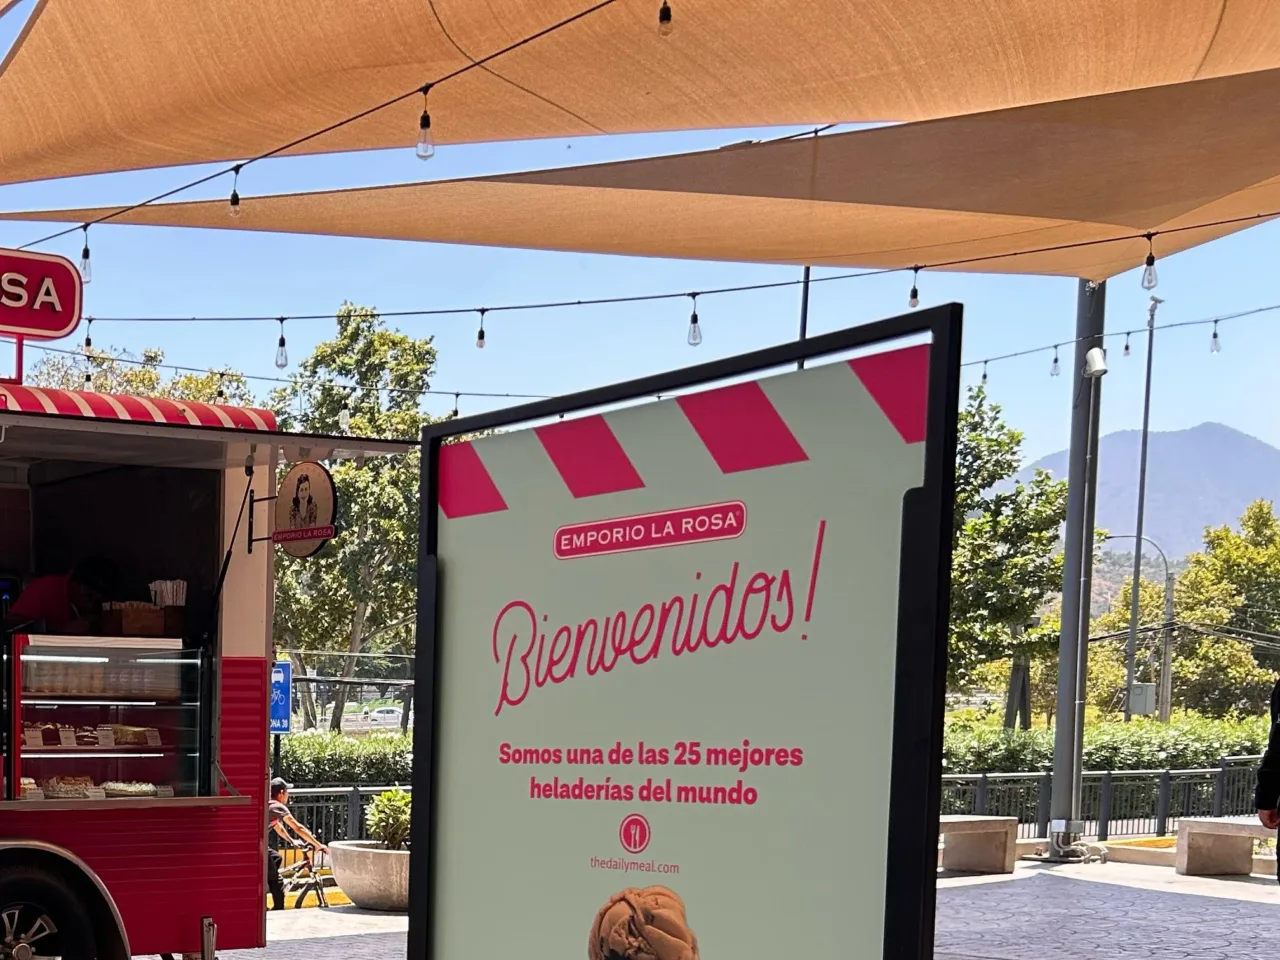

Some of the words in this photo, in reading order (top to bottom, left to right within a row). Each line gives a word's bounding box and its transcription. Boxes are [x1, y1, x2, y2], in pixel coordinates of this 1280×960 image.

[273, 531, 302, 541] EMPORIO
[303, 530, 312, 538] LA
[313, 528, 332, 537] ROSA
[561, 525, 645, 551] EMPORIO
[651, 520, 675, 539] LA
[681, 511, 737, 534] ROSA
[492, 519, 826, 717] Bienvenidos!
[270, 719, 281, 728] ONA
[282, 719, 288, 728] 30
[499, 742, 562, 764] Somos
[566, 747, 604, 765] una
[608, 742, 634, 765] de
[638, 742, 669, 766] las
[674, 742, 701, 766] 25
[705, 739, 804, 773] mejores
[529, 776, 634, 802] heladerías
[638, 778, 672, 803] del
[676, 779, 758, 806] mundo
[590, 856, 680, 874] thedailymeal.com
